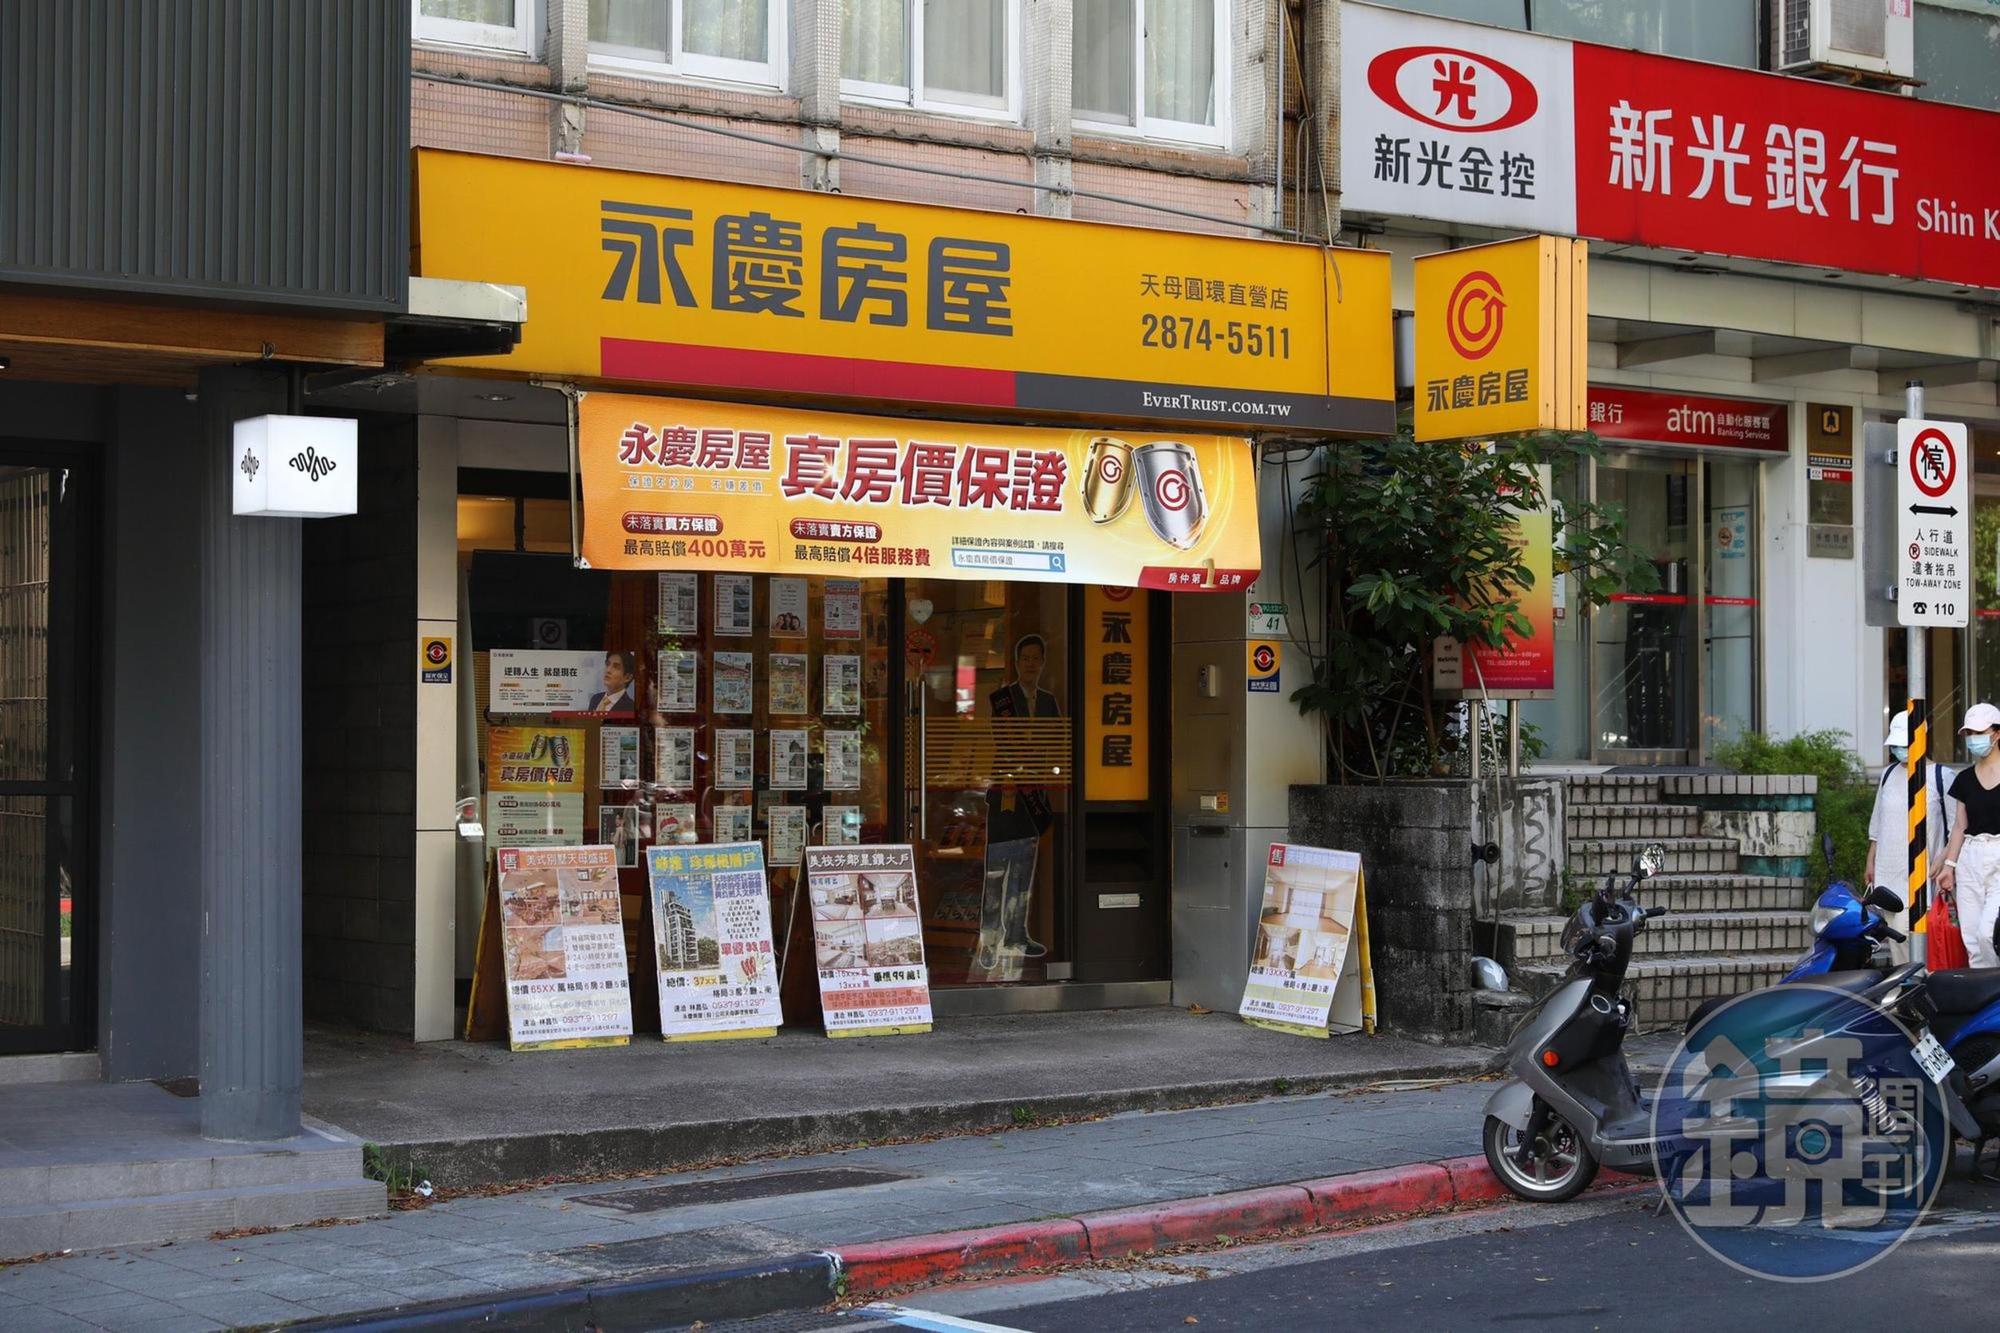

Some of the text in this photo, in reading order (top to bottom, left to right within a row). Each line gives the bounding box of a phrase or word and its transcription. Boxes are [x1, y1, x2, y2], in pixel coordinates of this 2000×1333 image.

[1374, 134, 1536, 200] 新光金控
[1607, 99, 1900, 226] 新光銀行
[1916, 197, 1974, 236] Shin
[601, 200, 1014, 336] 永慶房屋
[1140, 273, 1290, 311] 天母圓環直營店
[1141, 313, 1291, 360] 2874-5511
[1426, 368, 1529, 413] 永慶房屋
[1590, 401, 1623, 424] 銀行
[1666, 404, 1715, 435] atm
[1717, 413, 1770, 429] 自動化服務區
[1717, 428, 1770, 440] Banking Services
[619, 424, 772, 470] 永慶房屋
[781, 434, 1067, 512] 真房價保證
[626, 516, 718, 533] 未落實買方保證
[794, 523, 877, 540] 未落實賣方保證
[1915, 528, 1953, 544] 人行道
[624, 538, 766, 559] 最高賠償400萬元
[794, 544, 931, 568] 最高賠償4倍服務費
[1924, 546, 1959, 557] SIDEWALK
[1912, 561, 1956, 577] 違者拖吊
[1906, 577, 1962, 590] TOW-AWAY ZONE
[1934, 603, 1955, 615] 110
[1266, 616, 1280, 630] 41
[504, 666, 578, 677] 逆轉人生 就是現在
[1101, 611, 1133, 767] 永慶房屋
[500, 766, 574, 783] 真房價保證
[503, 854, 517, 869] 售
[1626, 1139, 1676, 1157] YAMAHA
